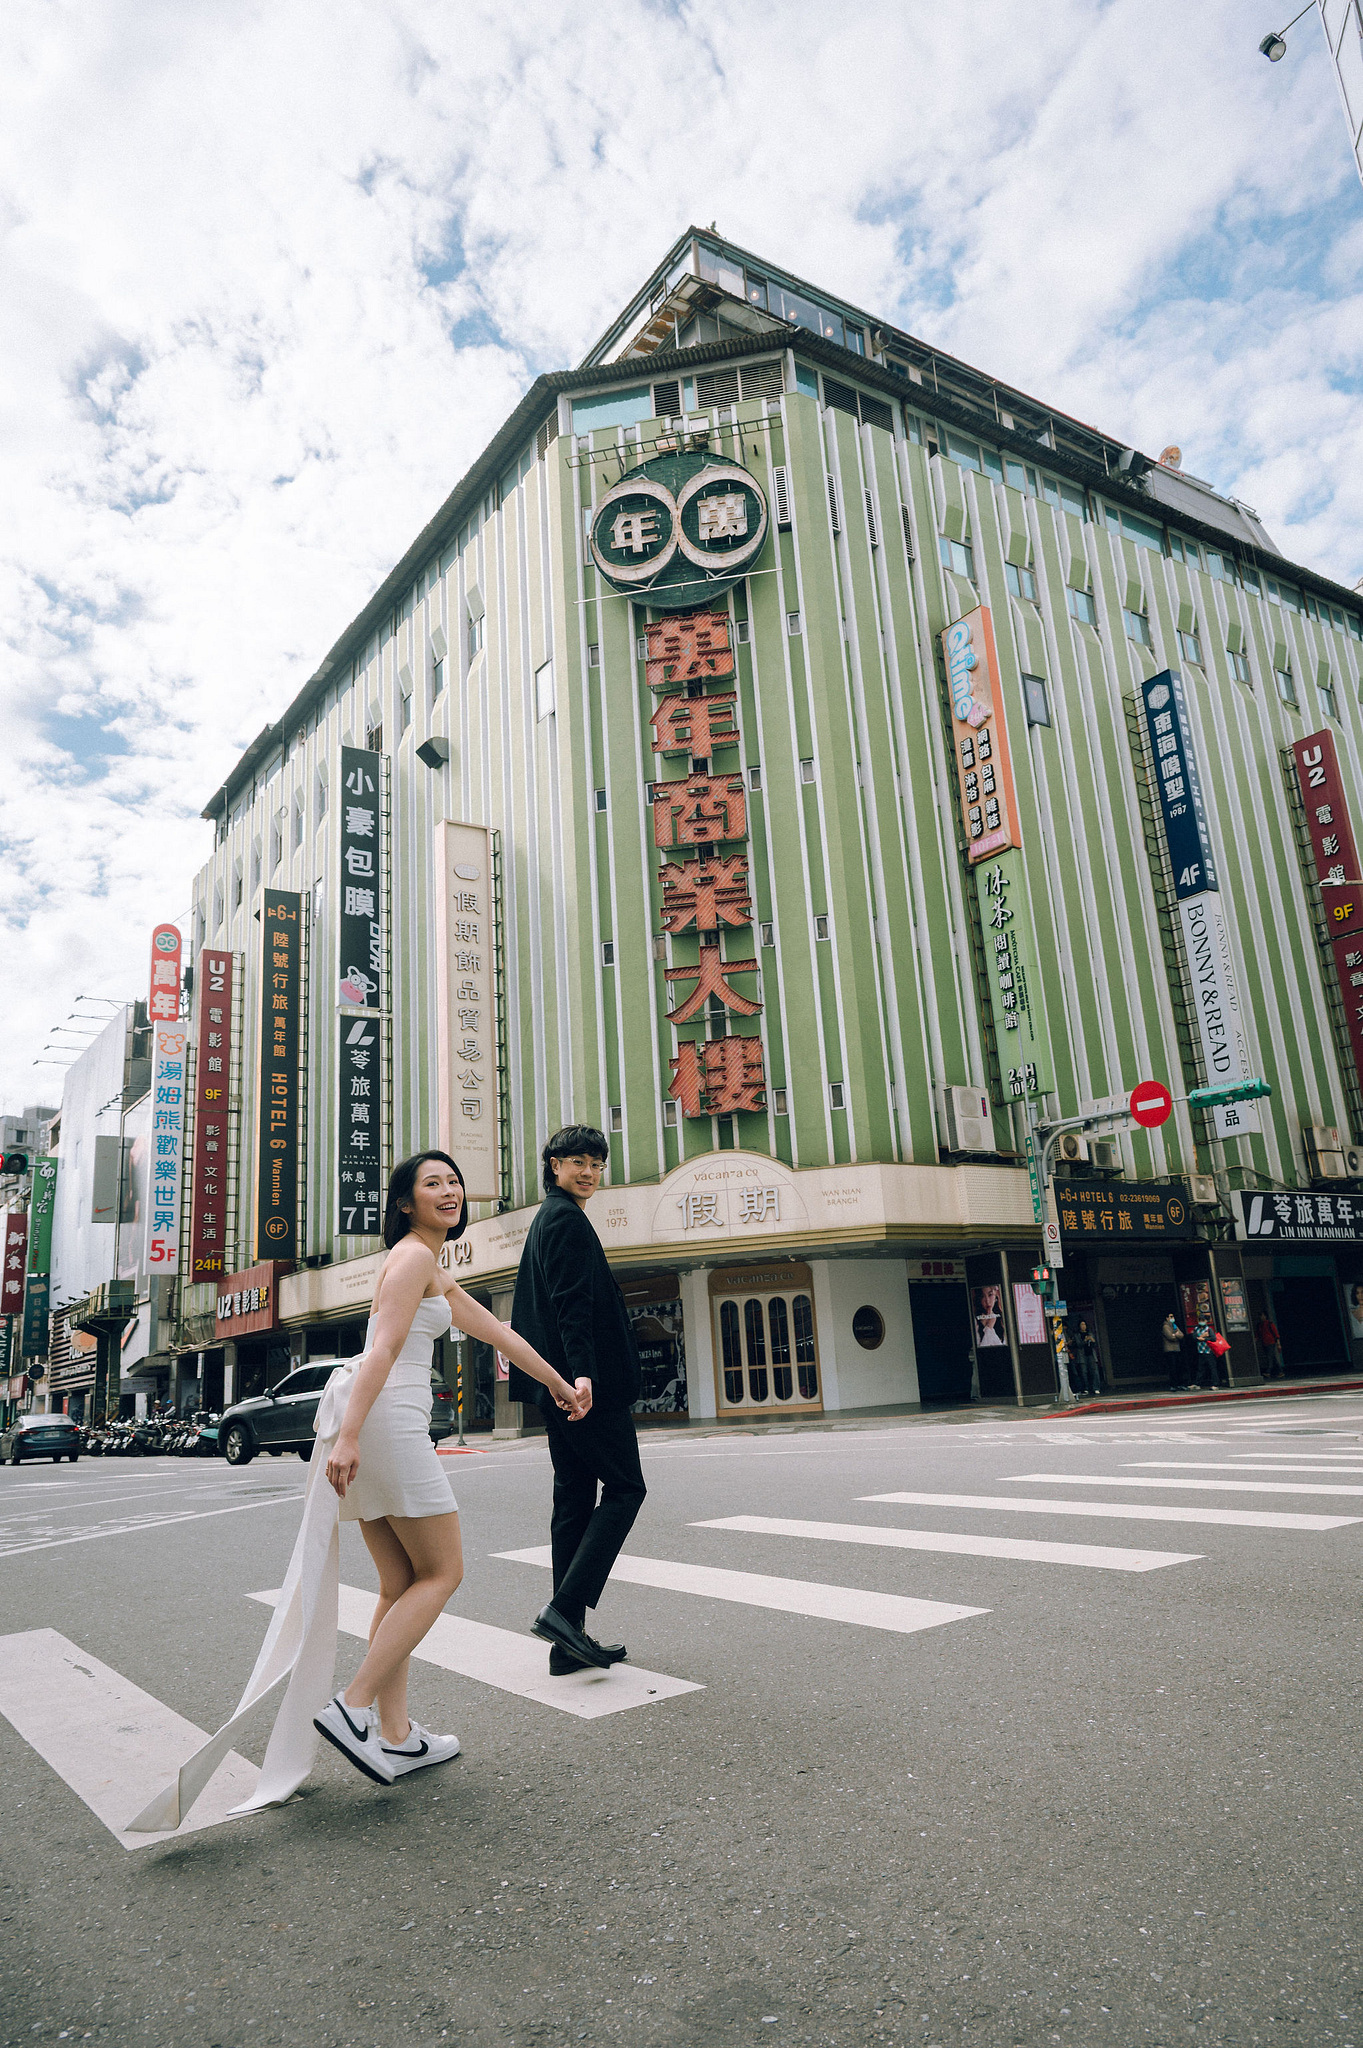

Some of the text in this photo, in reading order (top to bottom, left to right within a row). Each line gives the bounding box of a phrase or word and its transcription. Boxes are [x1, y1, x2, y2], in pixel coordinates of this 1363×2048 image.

[1153, 711, 1185, 802] 東海模型
[1302, 745, 1326, 788] U2
[1170, 805, 1187, 818] 1987
[345, 767, 375, 919] 小豪包膜
[643, 610, 767, 1118] 萬年商業大樓
[1179, 863, 1200, 887] 4F
[1333, 903, 1354, 922] 9F
[208, 959, 226, 992] U2
[151, 959, 178, 1018] 萬年
[272, 931, 289, 1058] 陸號行旅 萬年館
[453, 889, 484, 1120] 假期飾品貿易公司
[208, 1007, 223, 1073] 電影館
[205, 1088, 222, 1100] 9F
[270, 1072, 288, 1132] HOTEL
[350, 1049, 371, 1151] 苓旅萬年
[153, 1060, 183, 1233] 湯姆熊歡樂世界
[270, 1139, 287, 1149] 6
[341, 1171, 366, 1183] 休息
[354, 1190, 379, 1203] 住宿
[676, 1186, 780, 1230] 假期
[827, 1197, 858, 1206] BRANCH
[1080, 1191, 1107, 1203] HOTEL
[1108, 1192, 1114, 1203] 6
[342, 1206, 378, 1230] 7F
[608, 1208, 625, 1216] ESTD
[1062, 1210, 1133, 1231] 陸號行旅
[1170, 1206, 1181, 1218] 6F
[1272, 1194, 1354, 1226] 苓旅萬年
[269, 1223, 283, 1234] 6F
[606, 1217, 629, 1228] 1973
[1279, 1226, 1295, 1238] LIN
[1297, 1226, 1314, 1238] INN
[1314, 1227, 1356, 1238] WANNIAN
[149, 1239, 176, 1262] 5F
[194, 1258, 222, 1271] 24H
